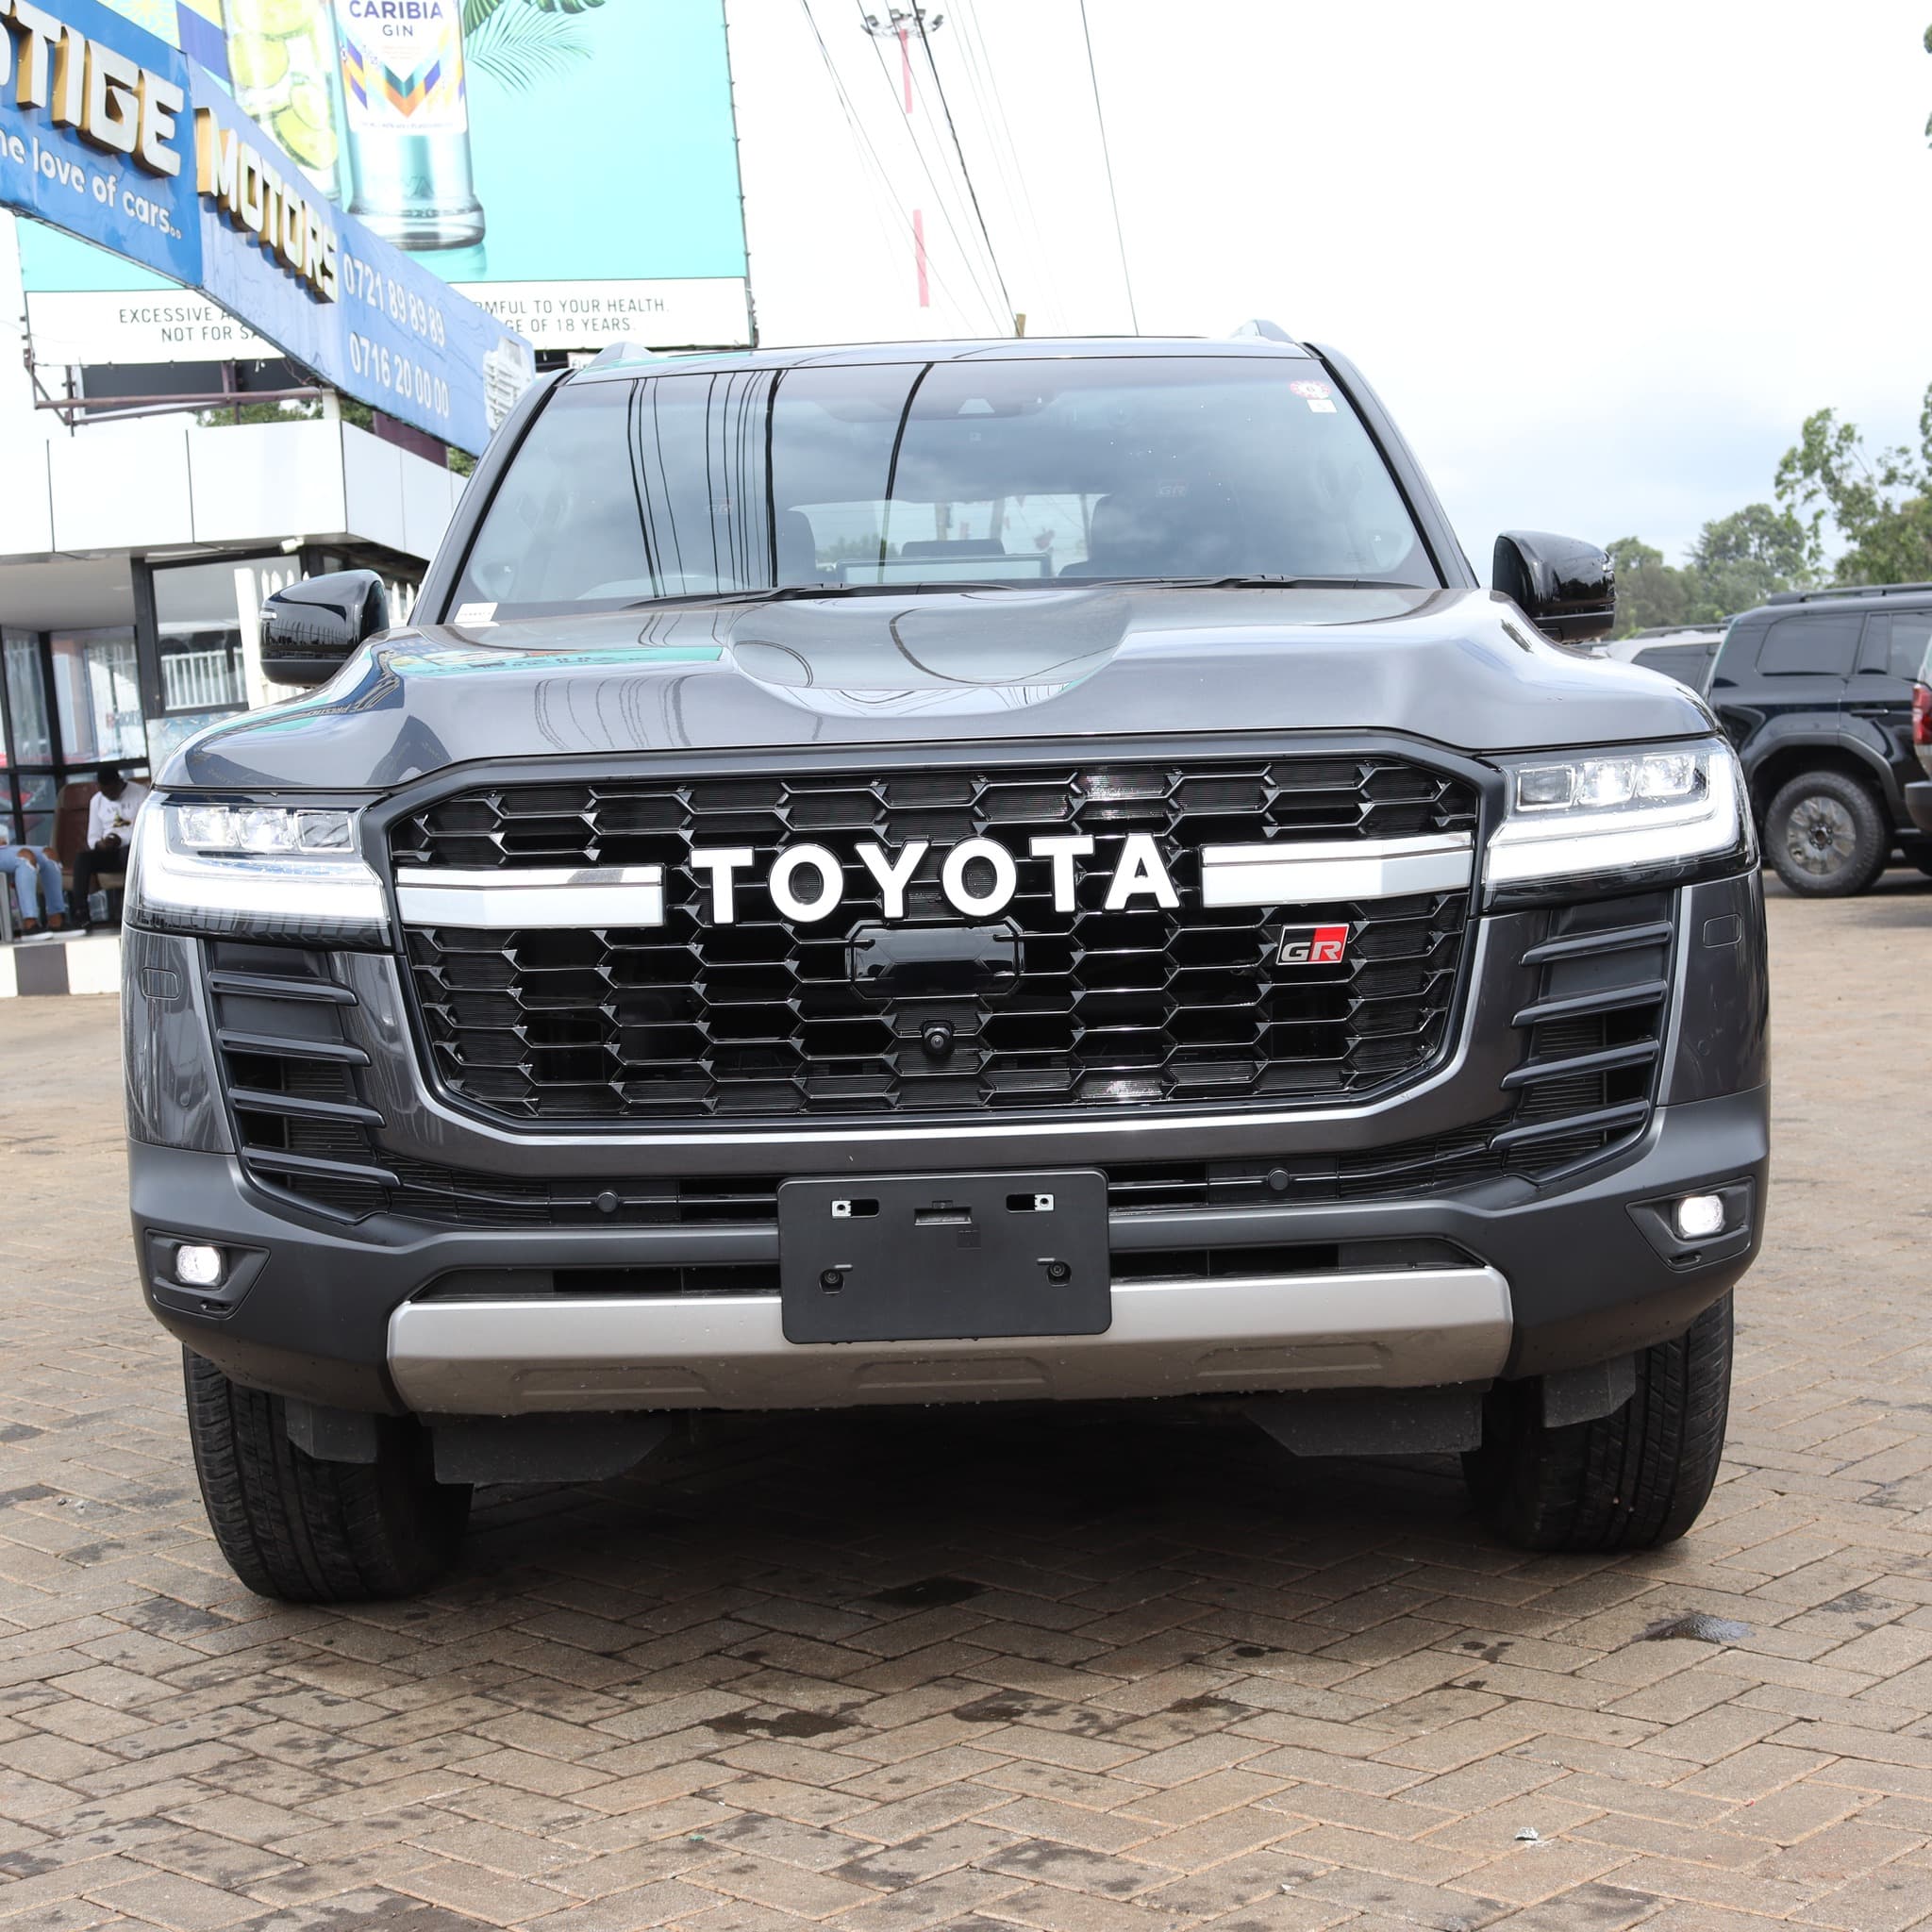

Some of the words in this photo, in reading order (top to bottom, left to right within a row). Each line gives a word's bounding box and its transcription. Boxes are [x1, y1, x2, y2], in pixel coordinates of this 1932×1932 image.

[349, 0, 443, 20] CARIBIA
[382, 25, 413, 37] GIN
[32, 136, 86, 194] love
[92, 175, 117, 208] of
[194, 107, 339, 306] MOTORS
[119, 307, 213, 324] EXCESSIVE
[533, 300, 553, 313] TO
[558, 299, 600, 313] YOUR
[343, 253, 384, 311] 0721
[388, 278, 408, 325] 89
[408, 292, 427, 338] 89
[428, 306, 445, 348] 89
[161, 326, 194, 342] NOT
[202, 326, 232, 341] FOR
[531, 319, 549, 332] OF
[558, 318, 575, 332] 18
[350, 331, 391, 388] 0716
[394, 354, 412, 399] 20
[415, 365, 432, 409] 00
[434, 376, 450, 419] 00
[690, 833, 1181, 925] TOYOTA
[1281, 941, 1342, 962] GR
